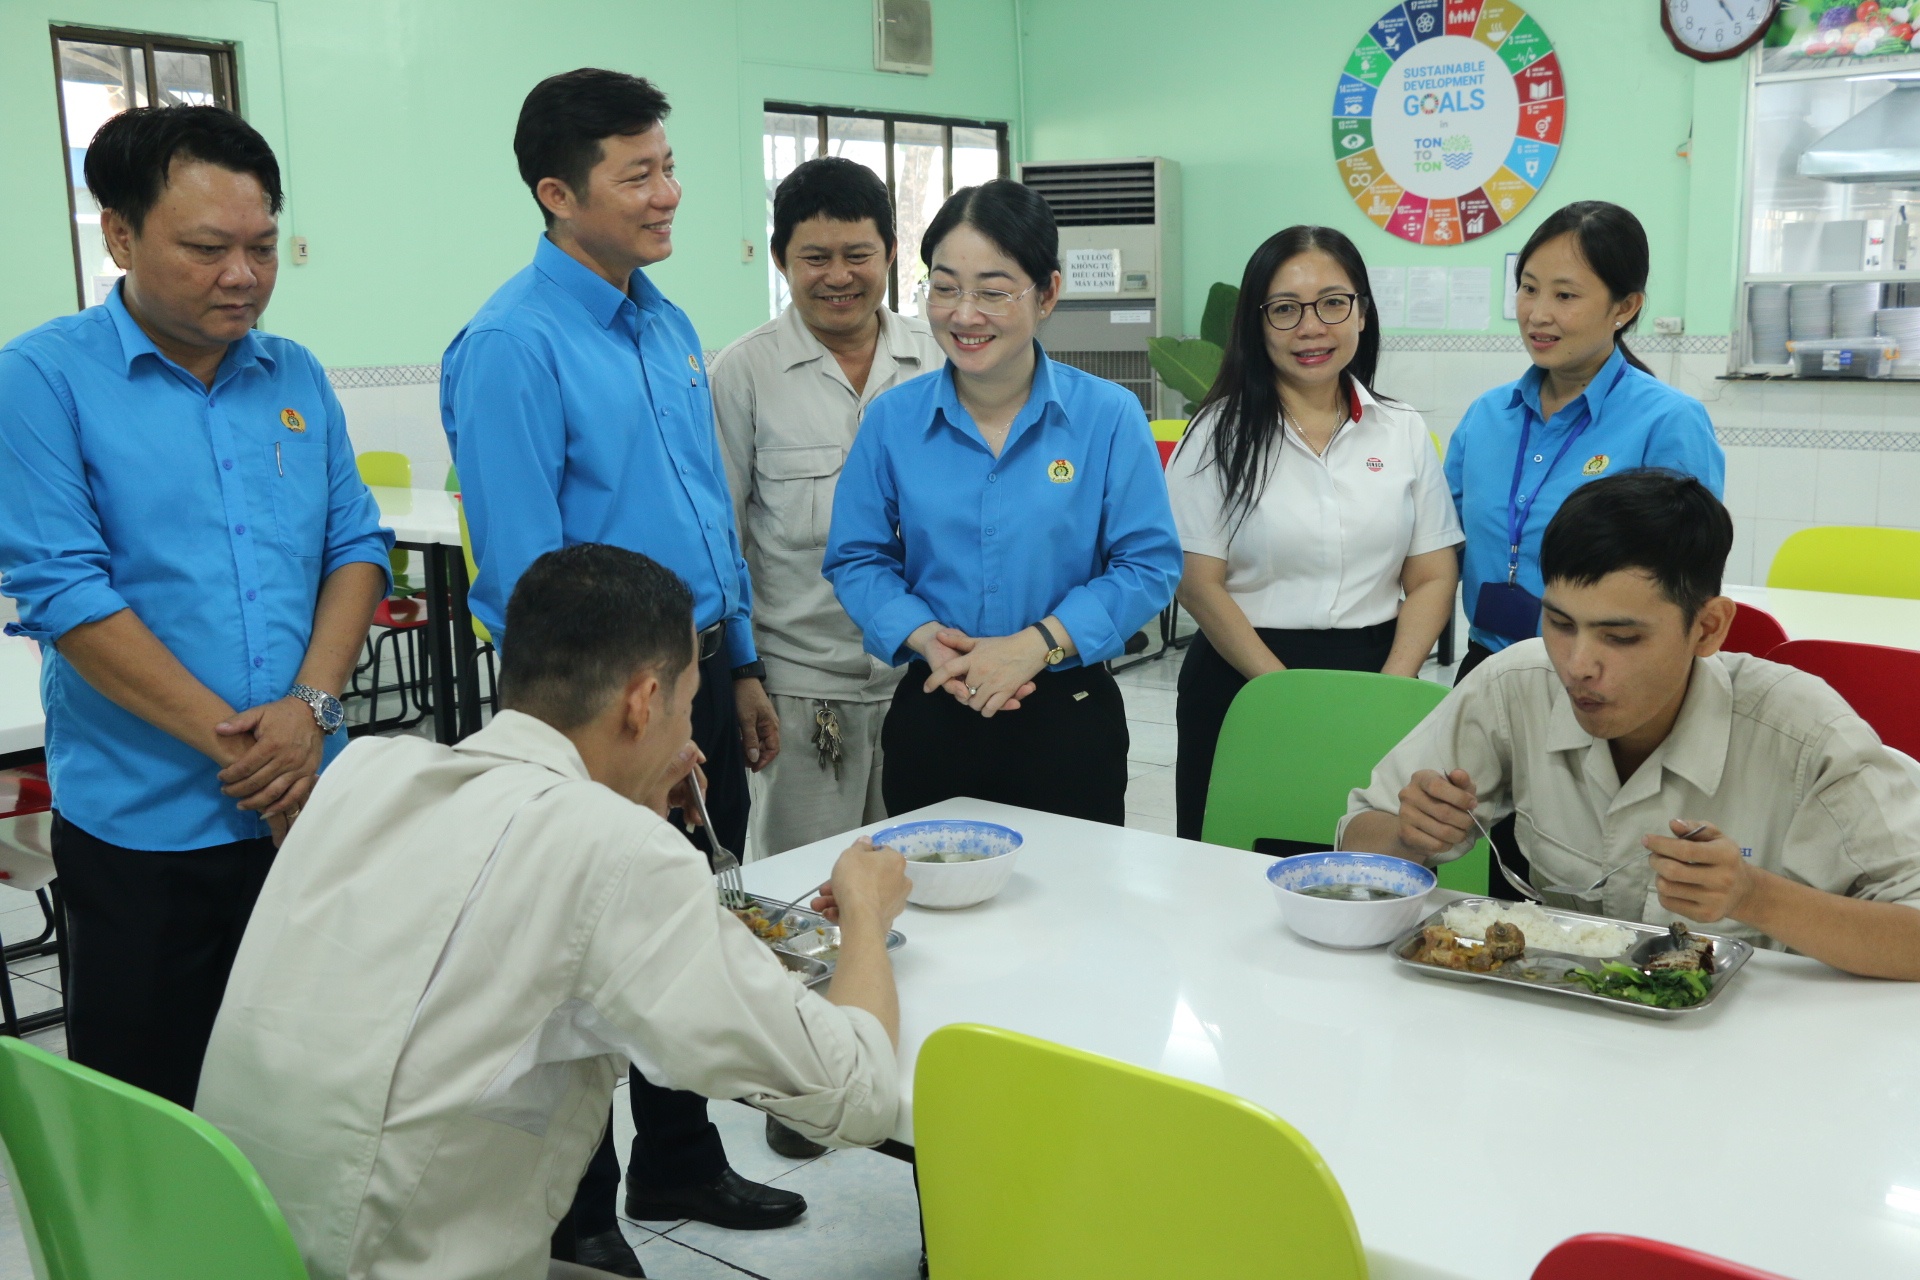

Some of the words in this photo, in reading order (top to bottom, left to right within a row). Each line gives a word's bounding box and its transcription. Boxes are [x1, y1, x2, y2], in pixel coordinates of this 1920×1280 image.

[1746, 6, 1755, 21] 4
[1685, 16, 1694, 30] 8
[1733, 22, 1742, 35] 5
[1697, 27, 1706, 41] 7
[1715, 28, 1724, 42] 6
[1403, 60, 1485, 79] SUSTAINABLE
[1403, 74, 1485, 92] DEVELOPMENT
[1403, 87, 1485, 116] GOALS
[1439, 120, 1448, 128] in
[1414, 137, 1442, 149] TON
[1414, 149, 1432, 161] TO
[1414, 161, 1442, 173] TON
